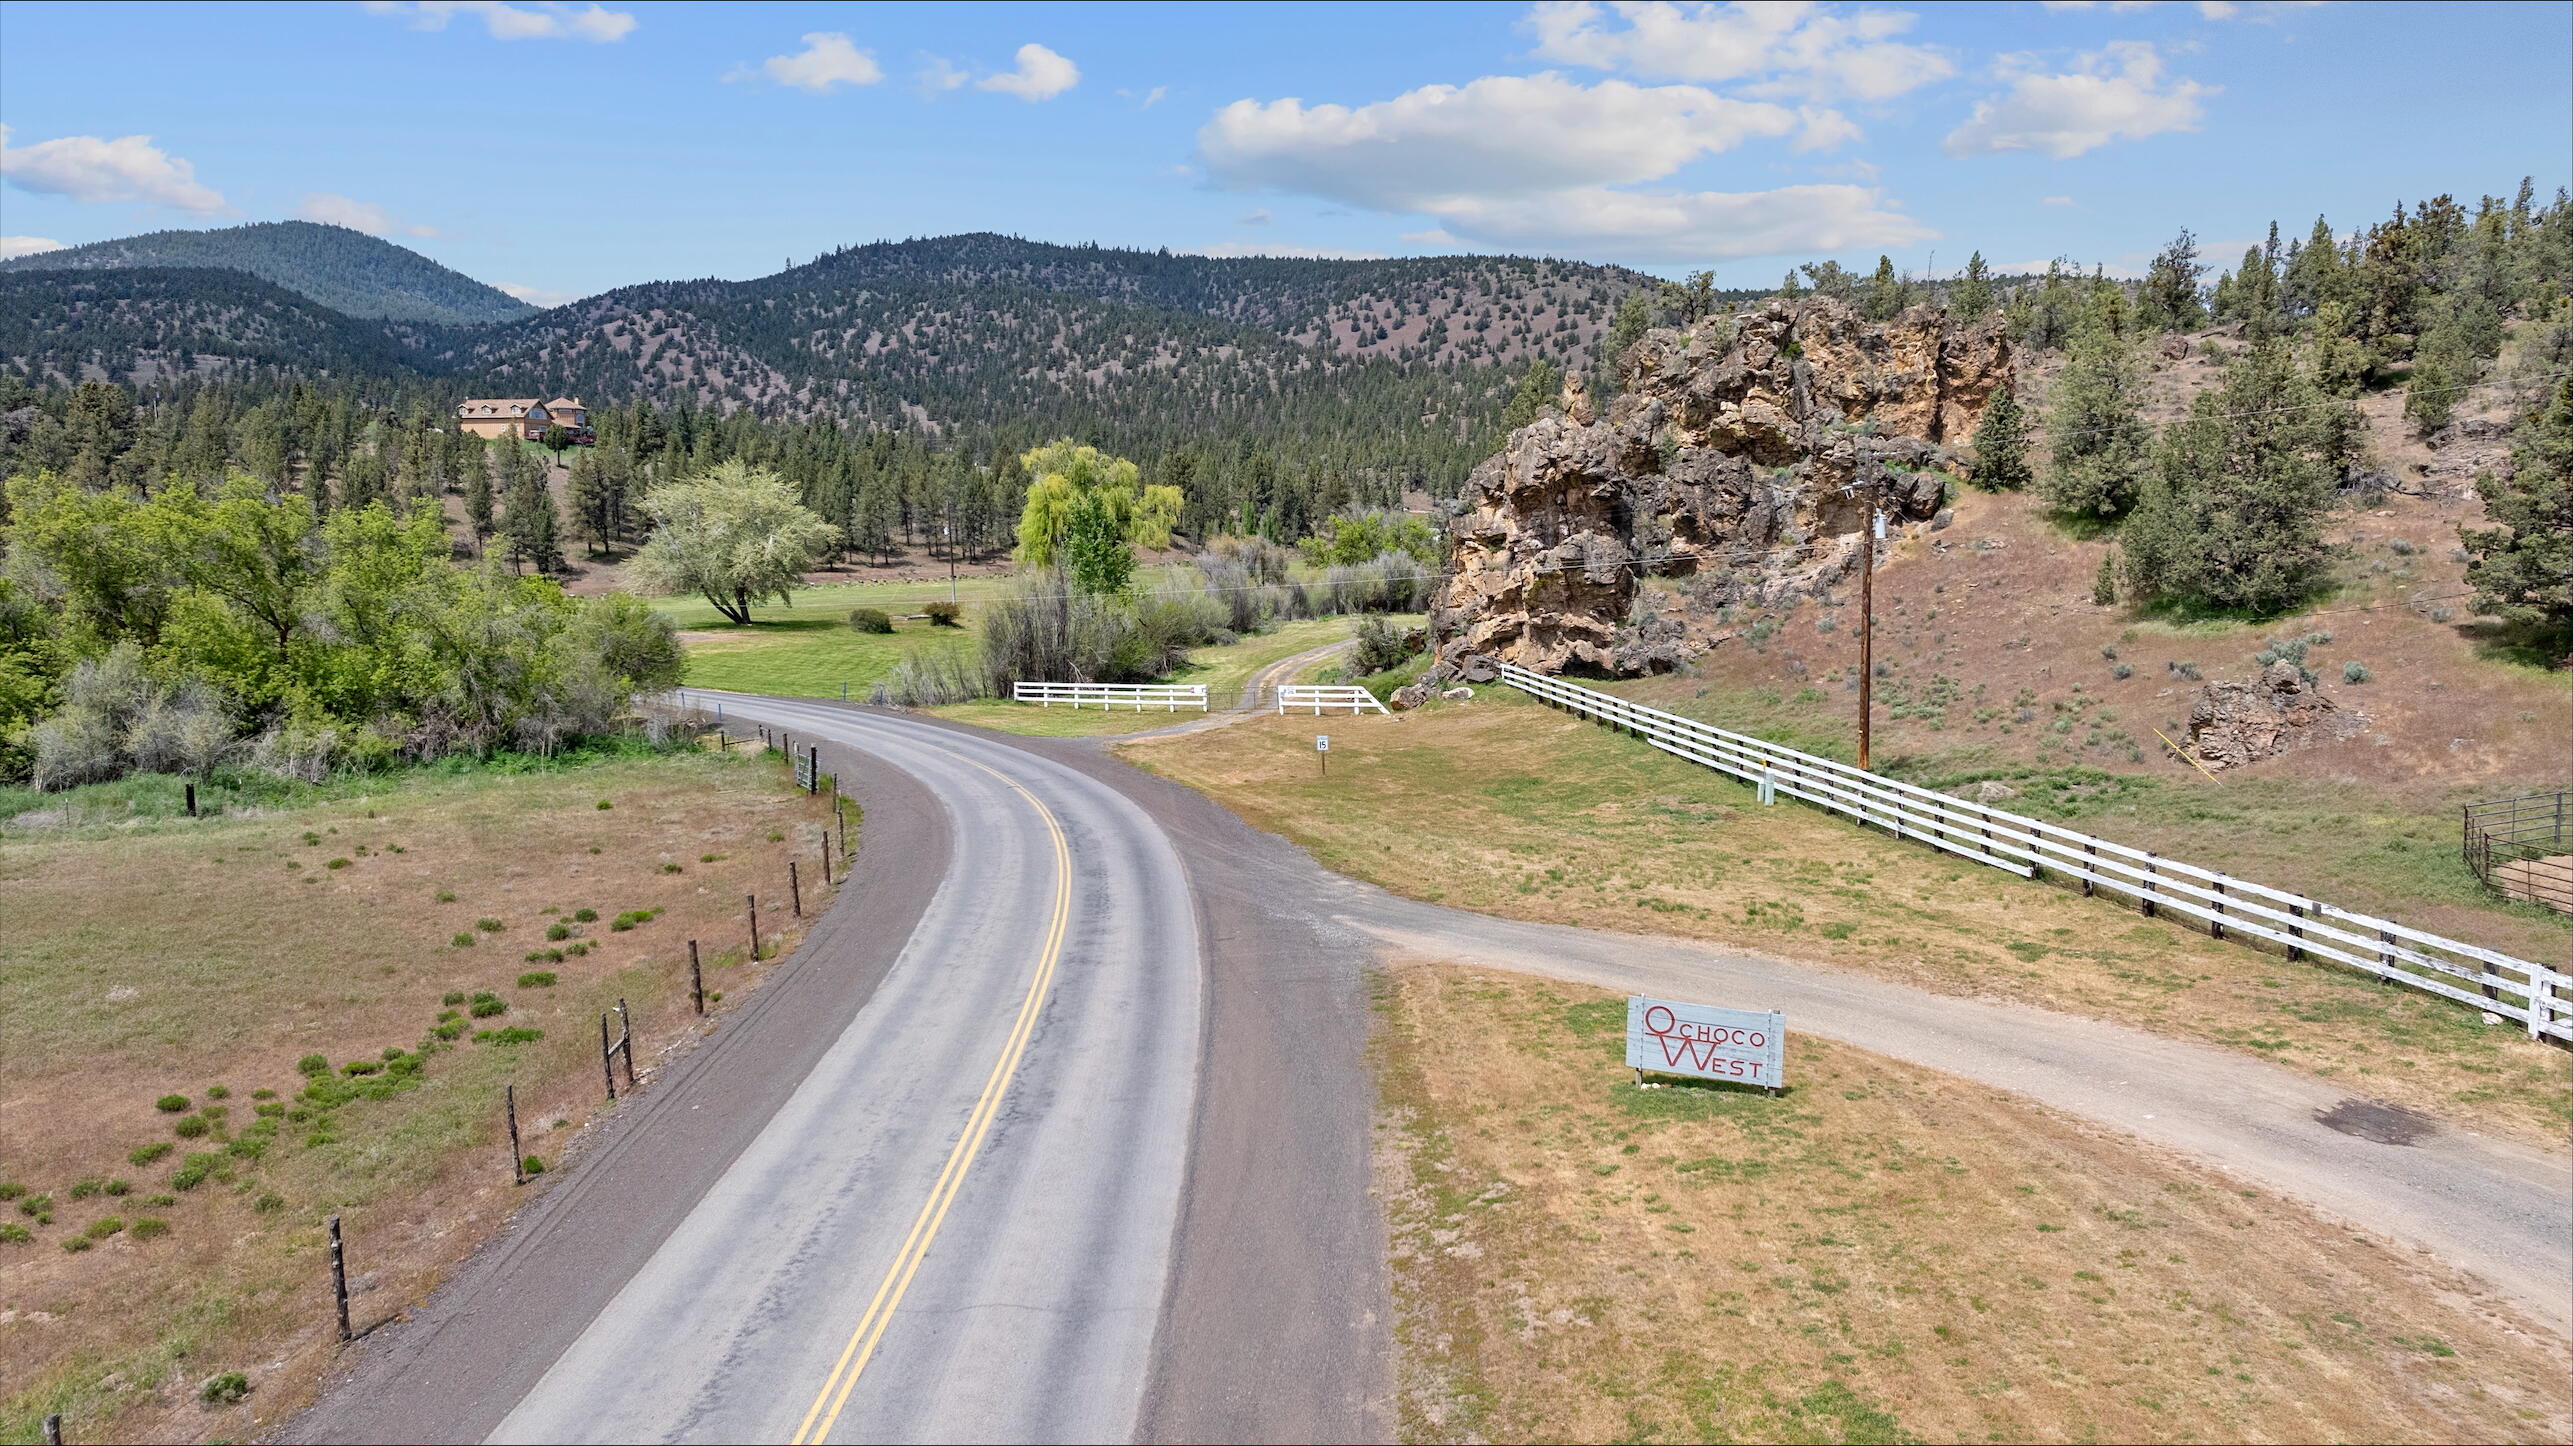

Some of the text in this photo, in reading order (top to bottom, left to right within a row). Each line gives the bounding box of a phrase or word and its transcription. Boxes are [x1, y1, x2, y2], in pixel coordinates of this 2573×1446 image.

[1319, 740, 1327, 749] 15
[1645, 1005, 1765, 1047] OCHOCO
[1645, 1032, 1763, 1078] WEST
